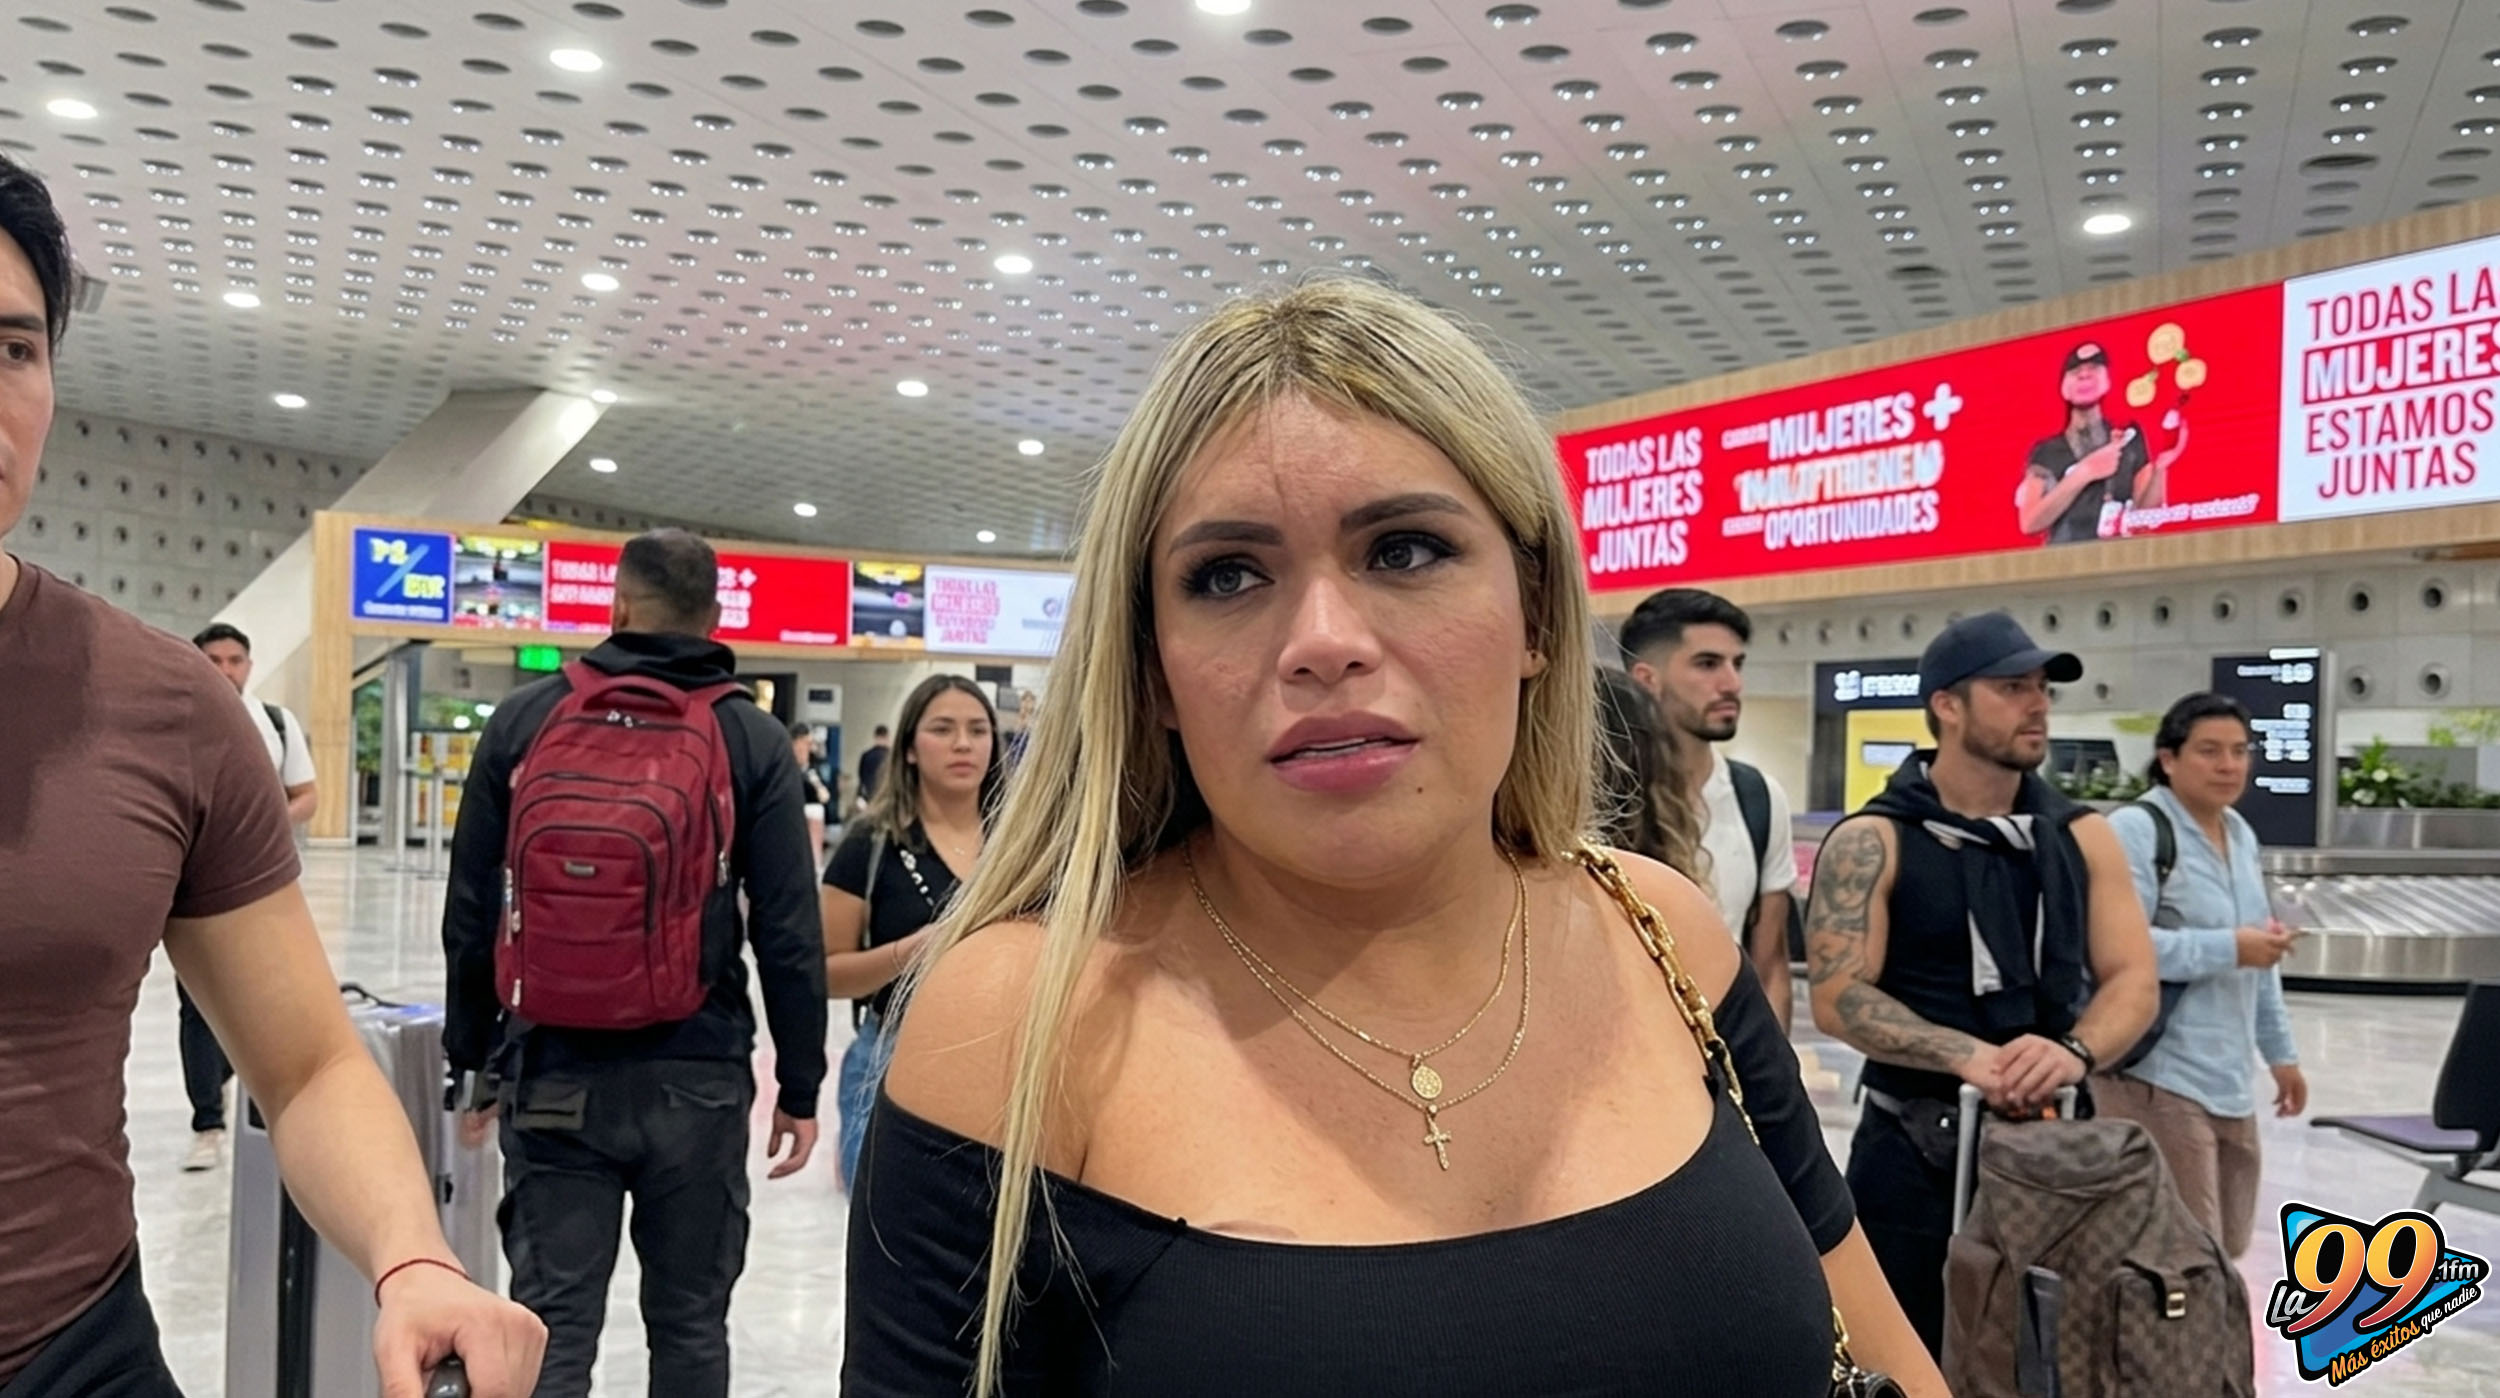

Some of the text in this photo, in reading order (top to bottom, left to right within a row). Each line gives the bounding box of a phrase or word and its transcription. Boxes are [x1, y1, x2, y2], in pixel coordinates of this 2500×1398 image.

[2307, 265, 2498, 341] TODAS LA
[1769, 391, 1915, 461] MUJERES
[2307, 387, 2494, 454] ESTAMOS
[1585, 436, 1655, 485] TODAS
[1657, 426, 1703, 473] LAS
[2318, 441, 2476, 499] JUNTAS
[1582, 468, 1703, 531] MUJERES
[1764, 490, 1939, 550] OPORTUNIDADES
[1589, 519, 1688, 574] JUNTAS
